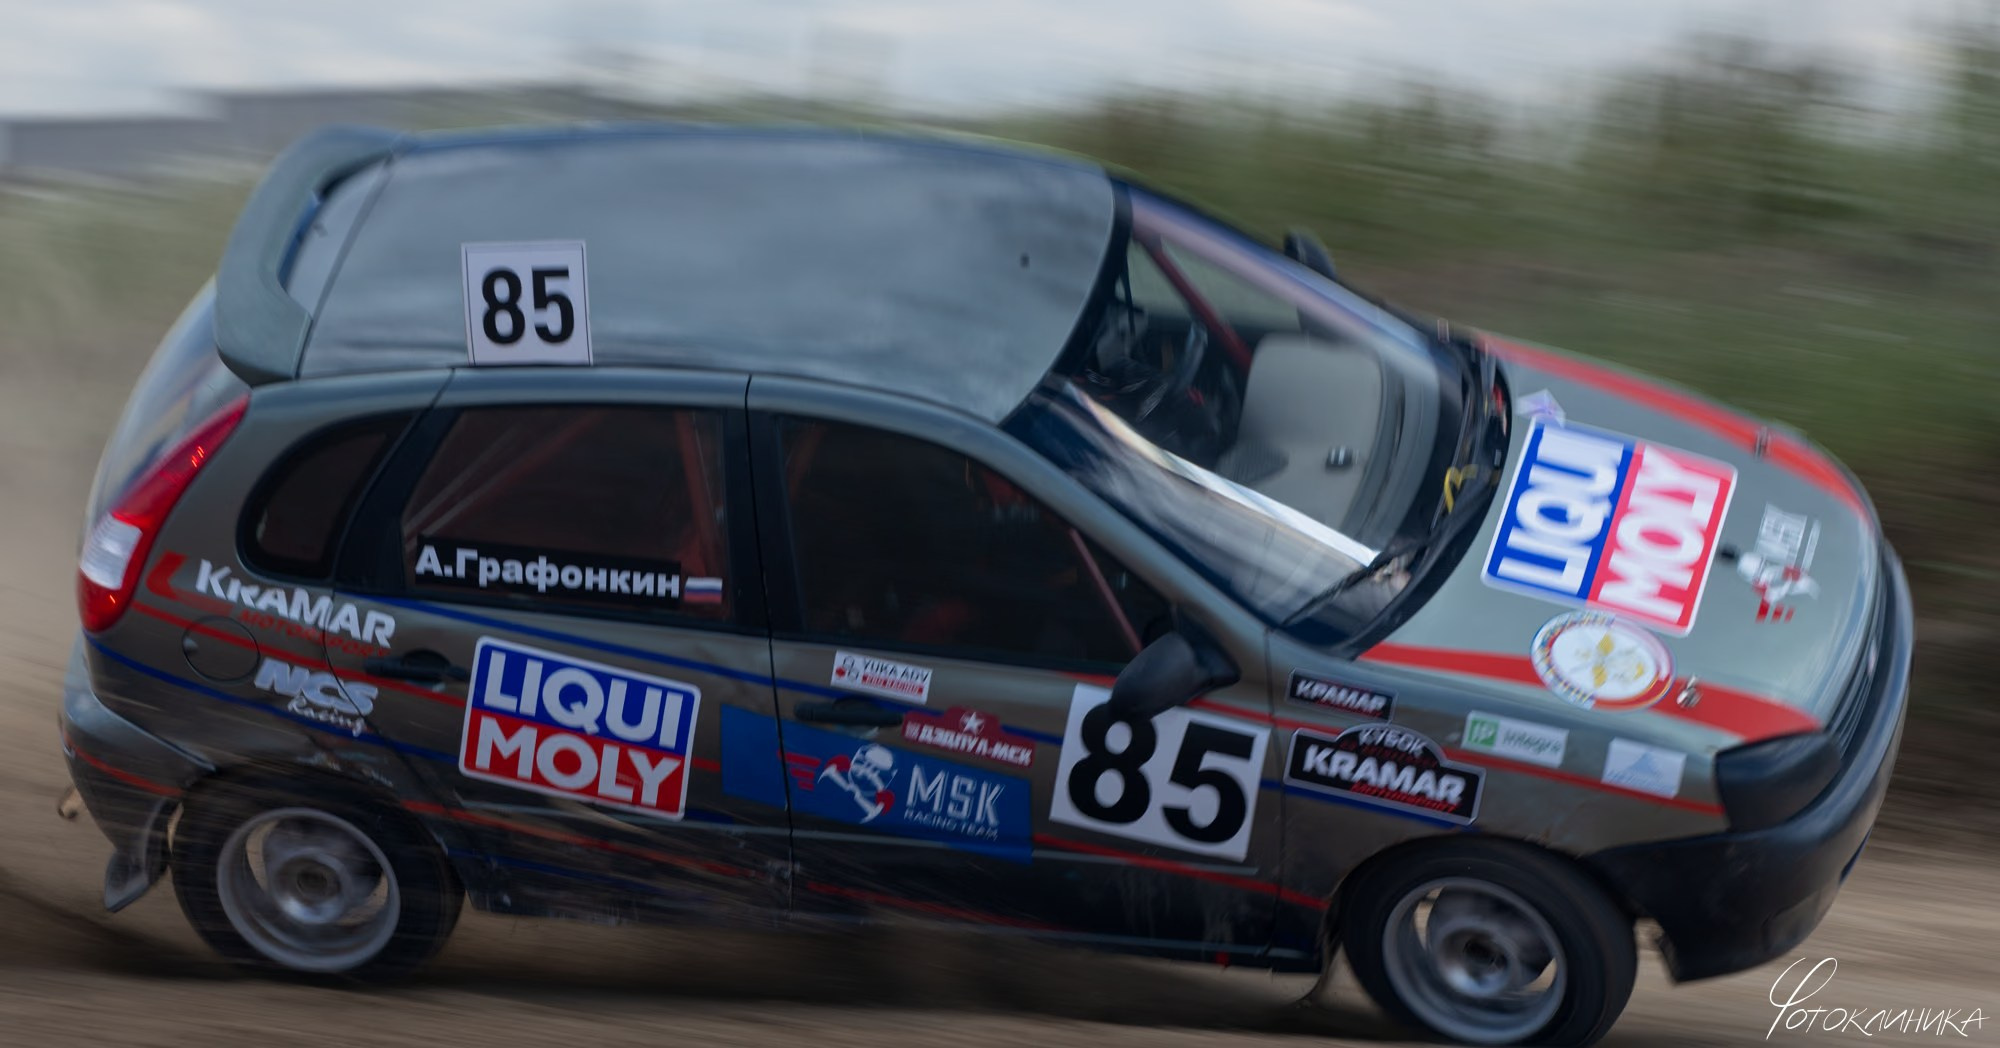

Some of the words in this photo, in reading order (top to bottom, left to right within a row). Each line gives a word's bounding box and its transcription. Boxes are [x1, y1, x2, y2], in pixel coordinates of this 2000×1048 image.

[481, 266, 575, 345] 85
[1496, 424, 1626, 596] LIQUI
[1597, 445, 1720, 625] MOLY
[415, 544, 680, 598] А.Графонкин
[254, 657, 379, 716] NCS
[483, 650, 684, 749] LIQUI
[475, 715, 682, 807] MOLY
[905, 763, 1005, 827] MSK
[1068, 703, 1256, 844] 85
[1302, 744, 1466, 806] KRAMAR
